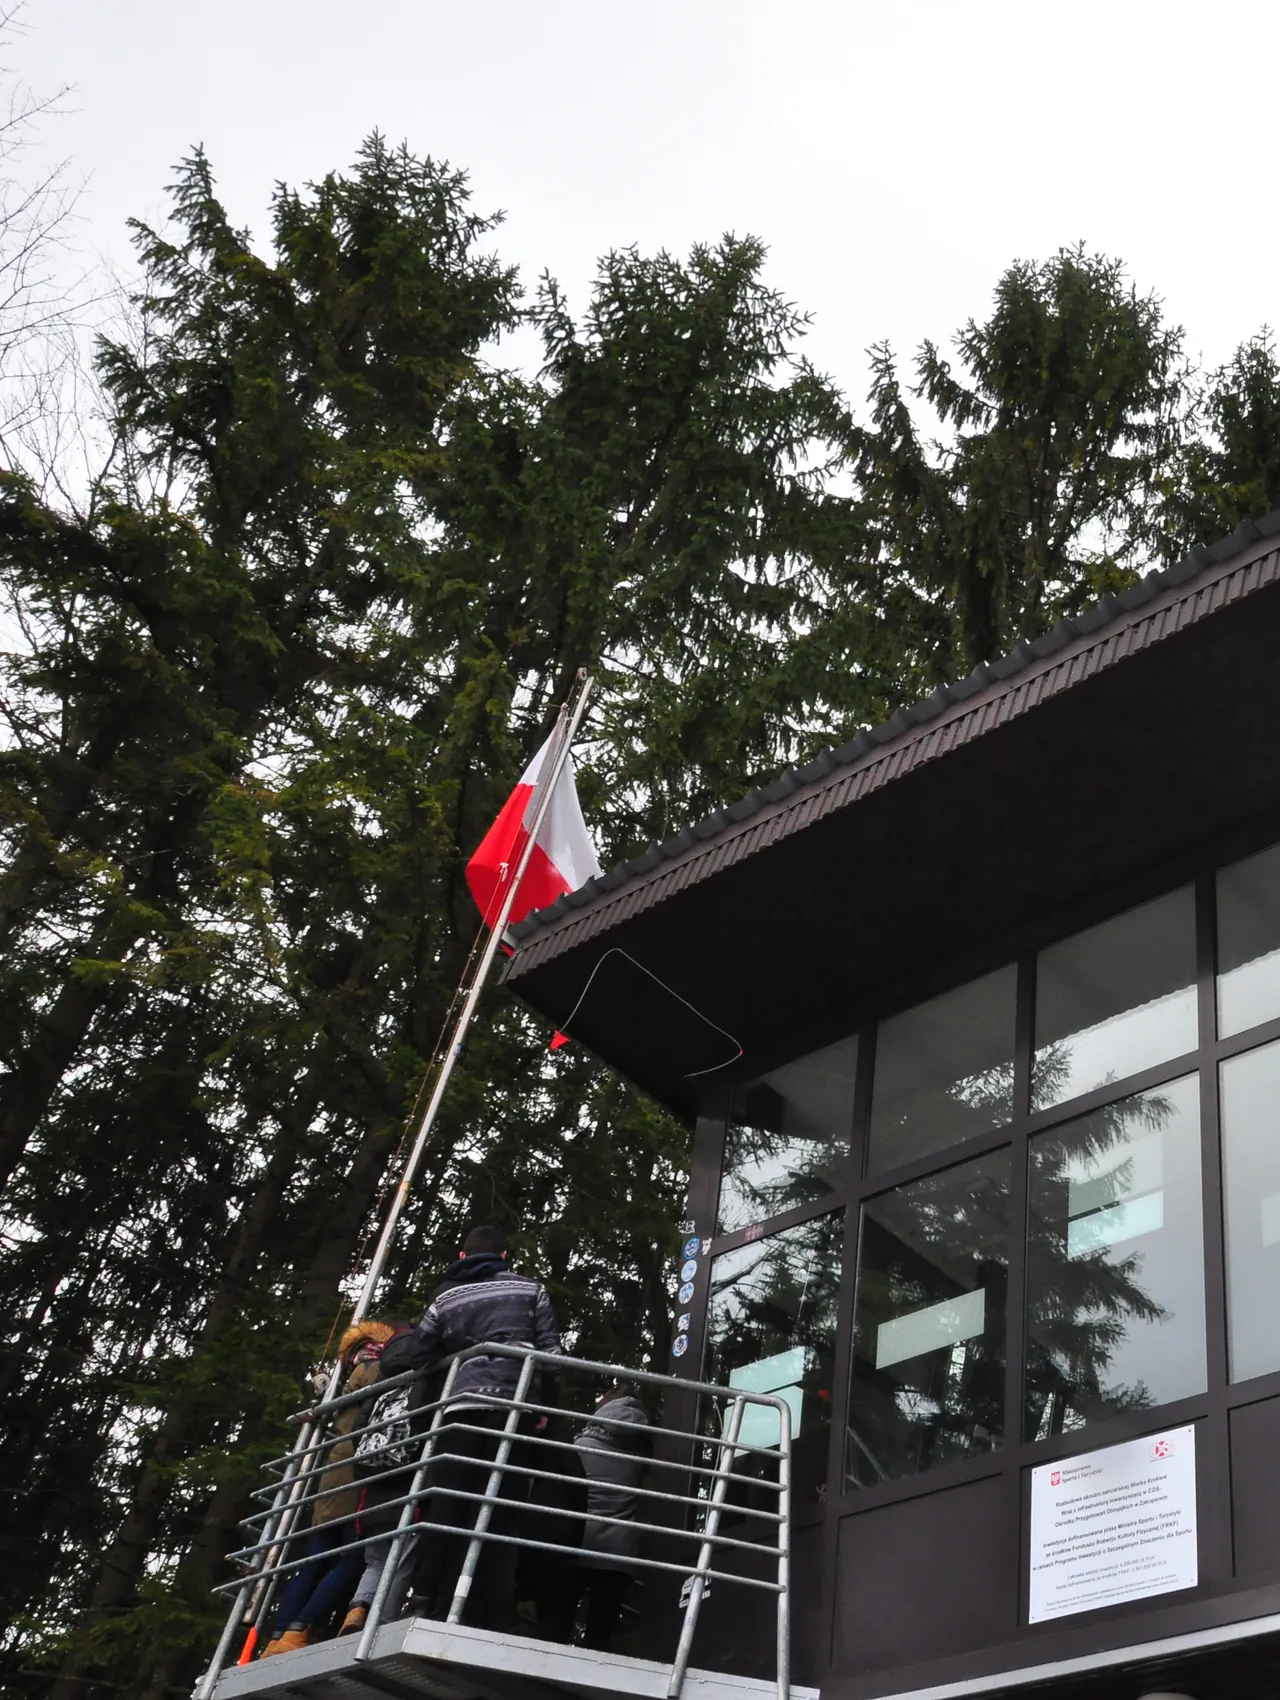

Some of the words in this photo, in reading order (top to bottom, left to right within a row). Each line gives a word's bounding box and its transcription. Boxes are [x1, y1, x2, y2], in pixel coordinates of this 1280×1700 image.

[1056, 1497, 1082, 1507] Rozbudowa
[1083, 1492, 1101, 1500] skoczni
[1102, 1484, 1129, 1495] narciarskiej
[1130, 1480, 1146, 1488] Wielka
[1147, 1475, 1167, 1483] Krokiew
[1077, 1500, 1108, 1512] infrastrukturą
[1109, 1492, 1142, 1504] towarzyszącą
[1076, 1510, 1105, 1522] Przygotowań
[1140, 1495, 1168, 1506] Zakopanem
[1068, 1529, 1103, 1542] dofinansowana
[1104, 1526, 1116, 1534] przez
[1118, 1521, 1137, 1529] Ministra
[1159, 1509, 1181, 1519] Turystyki
[1072, 1542, 1095, 1551] Funduszu
[1096, 1536, 1116, 1545] Rozwoju
[1118, 1532, 1135, 1540] Kultury
[1136, 1525, 1159, 1535] Fizycznej
[1037, 1562, 1054, 1570] ramach
[1055, 1557, 1077, 1565] Programu
[1107, 1541, 1139, 1553] Szczególnym
[1140, 1535, 1165, 1545] Znaczeniu
